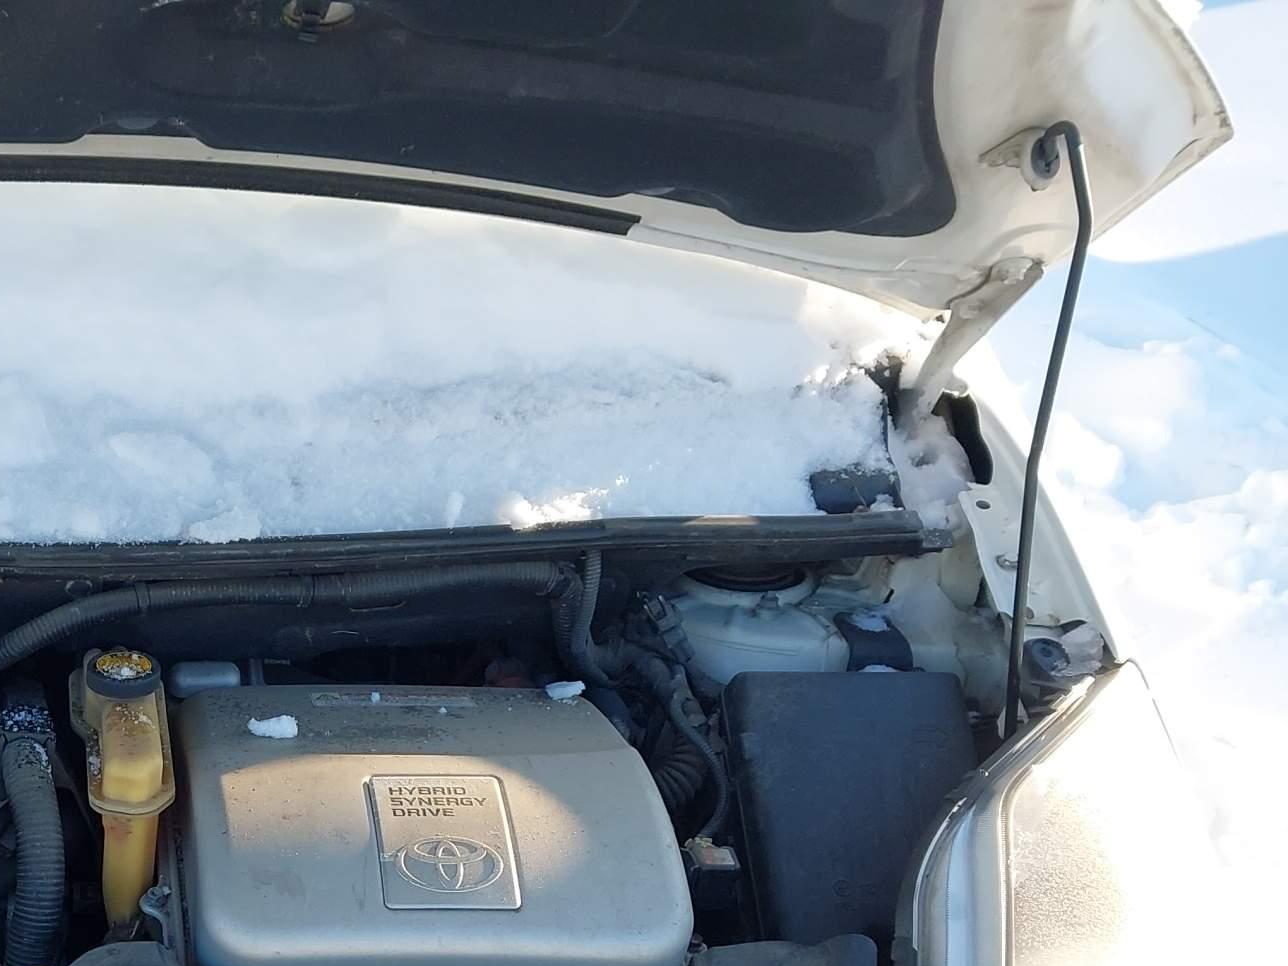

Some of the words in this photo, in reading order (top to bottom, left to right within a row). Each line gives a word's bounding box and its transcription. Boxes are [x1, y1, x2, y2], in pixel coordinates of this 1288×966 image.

[388, 786, 466, 796] HYBRID
[390, 797, 487, 807] SYNERGY
[392, 808, 455, 817] DRIVE
